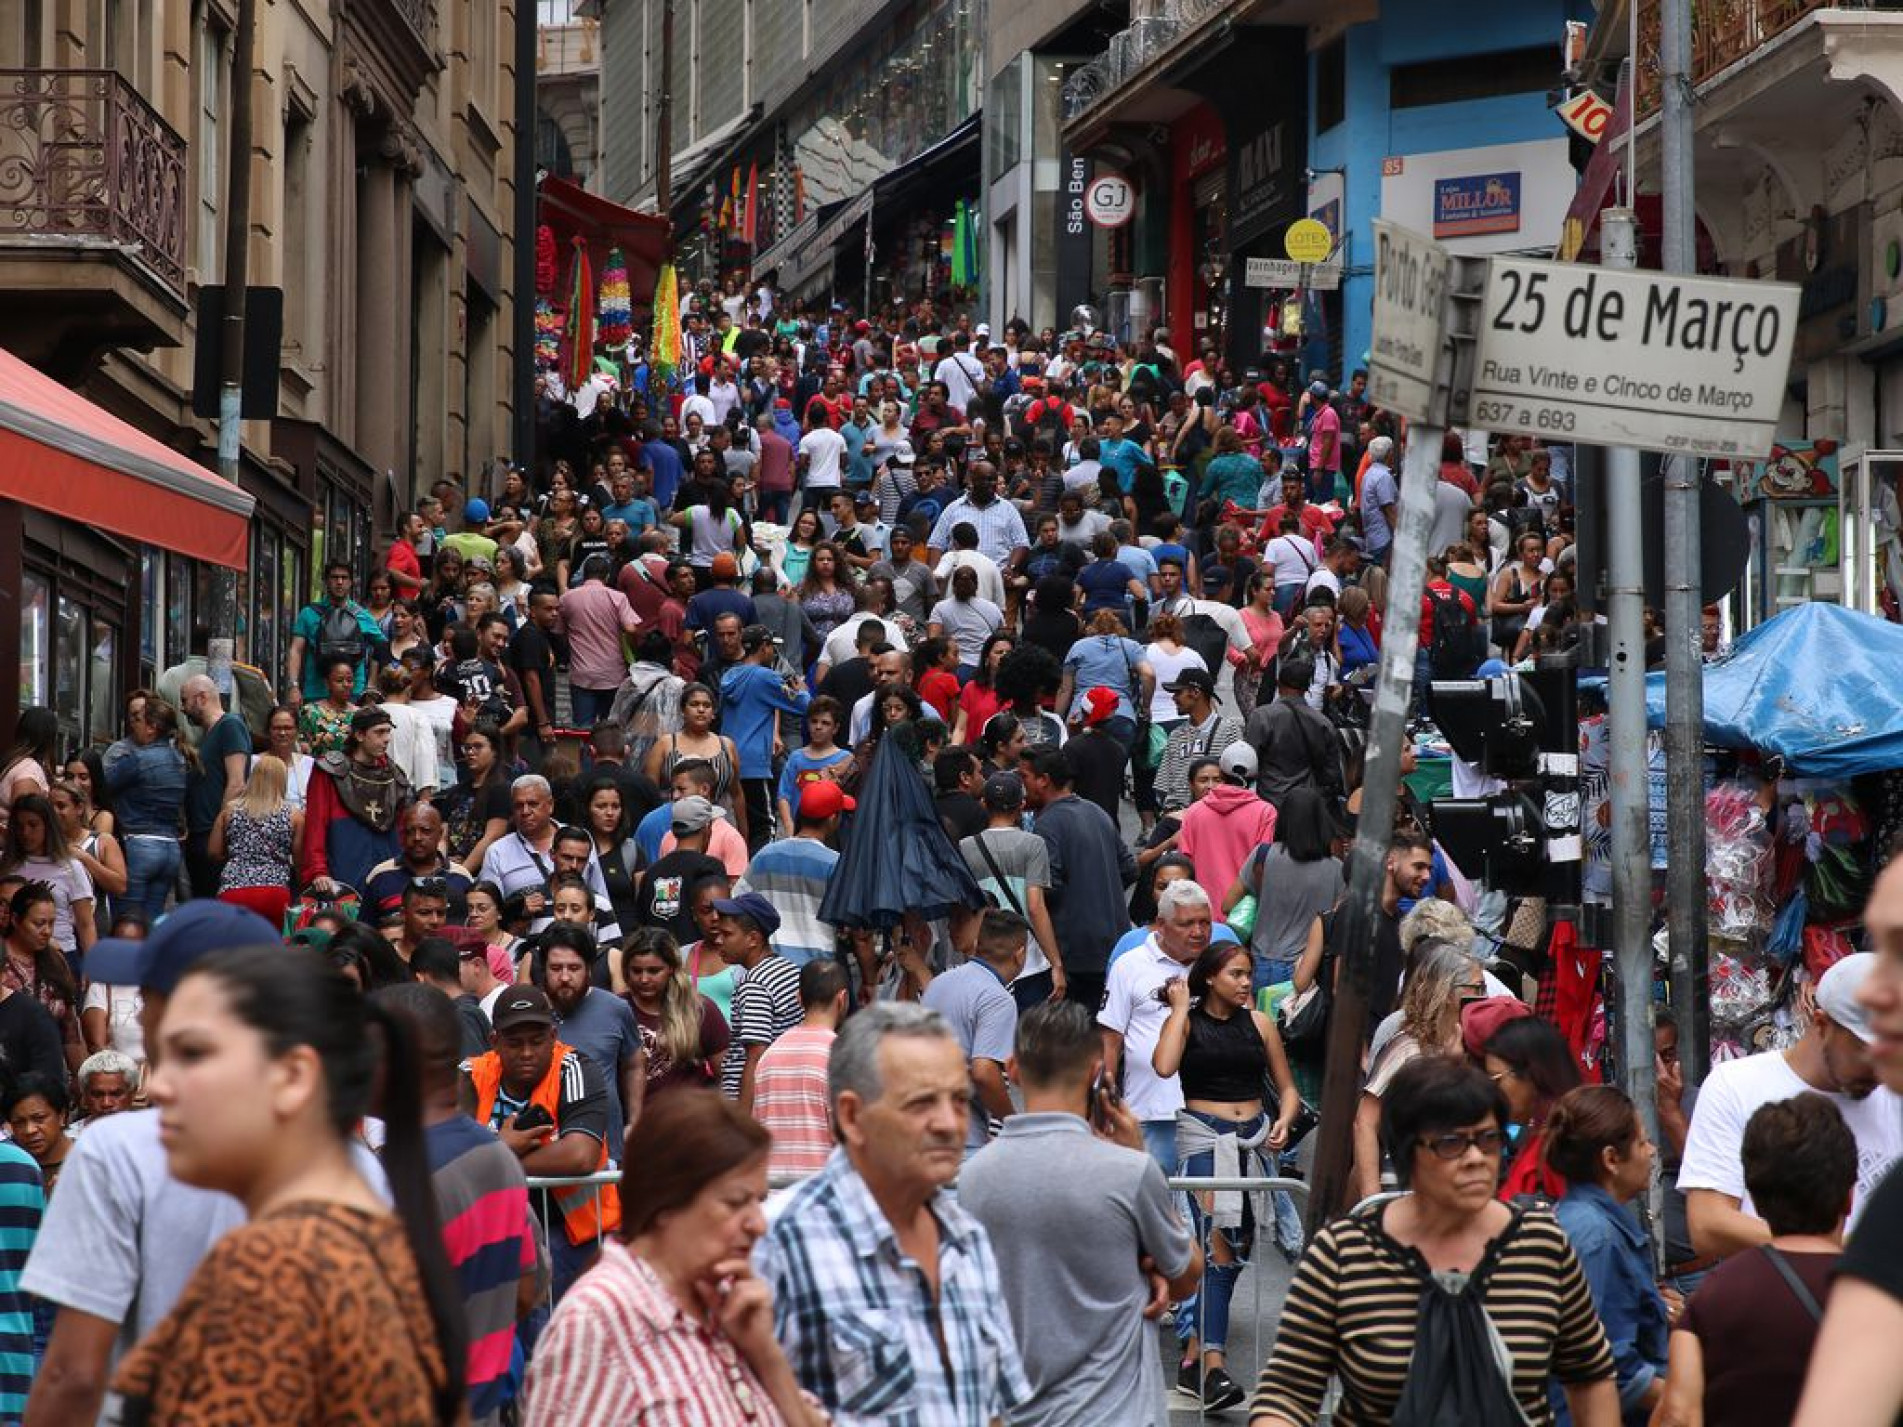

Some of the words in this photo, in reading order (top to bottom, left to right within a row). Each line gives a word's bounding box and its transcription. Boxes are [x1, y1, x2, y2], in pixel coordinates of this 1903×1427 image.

[1384, 160, 1400, 173] 85
[1094, 183, 1127, 207] GJ
[1068, 197, 1083, 234] São
[1493, 269, 1548, 333] 25
[1564, 273, 1624, 341] de
[1641, 283, 1780, 373] Março
[1482, 360, 1520, 383] Rua
[1529, 366, 1578, 391] Vinte
[1584, 376, 1598, 392] e
[1603, 374, 1661, 399] Cinco
[1667, 382, 1693, 404] de
[1698, 386, 1754, 412] Março
[1476, 400, 1513, 421] 637
[1518, 410, 1531, 424] a
[1537, 410, 1576, 431] 693
